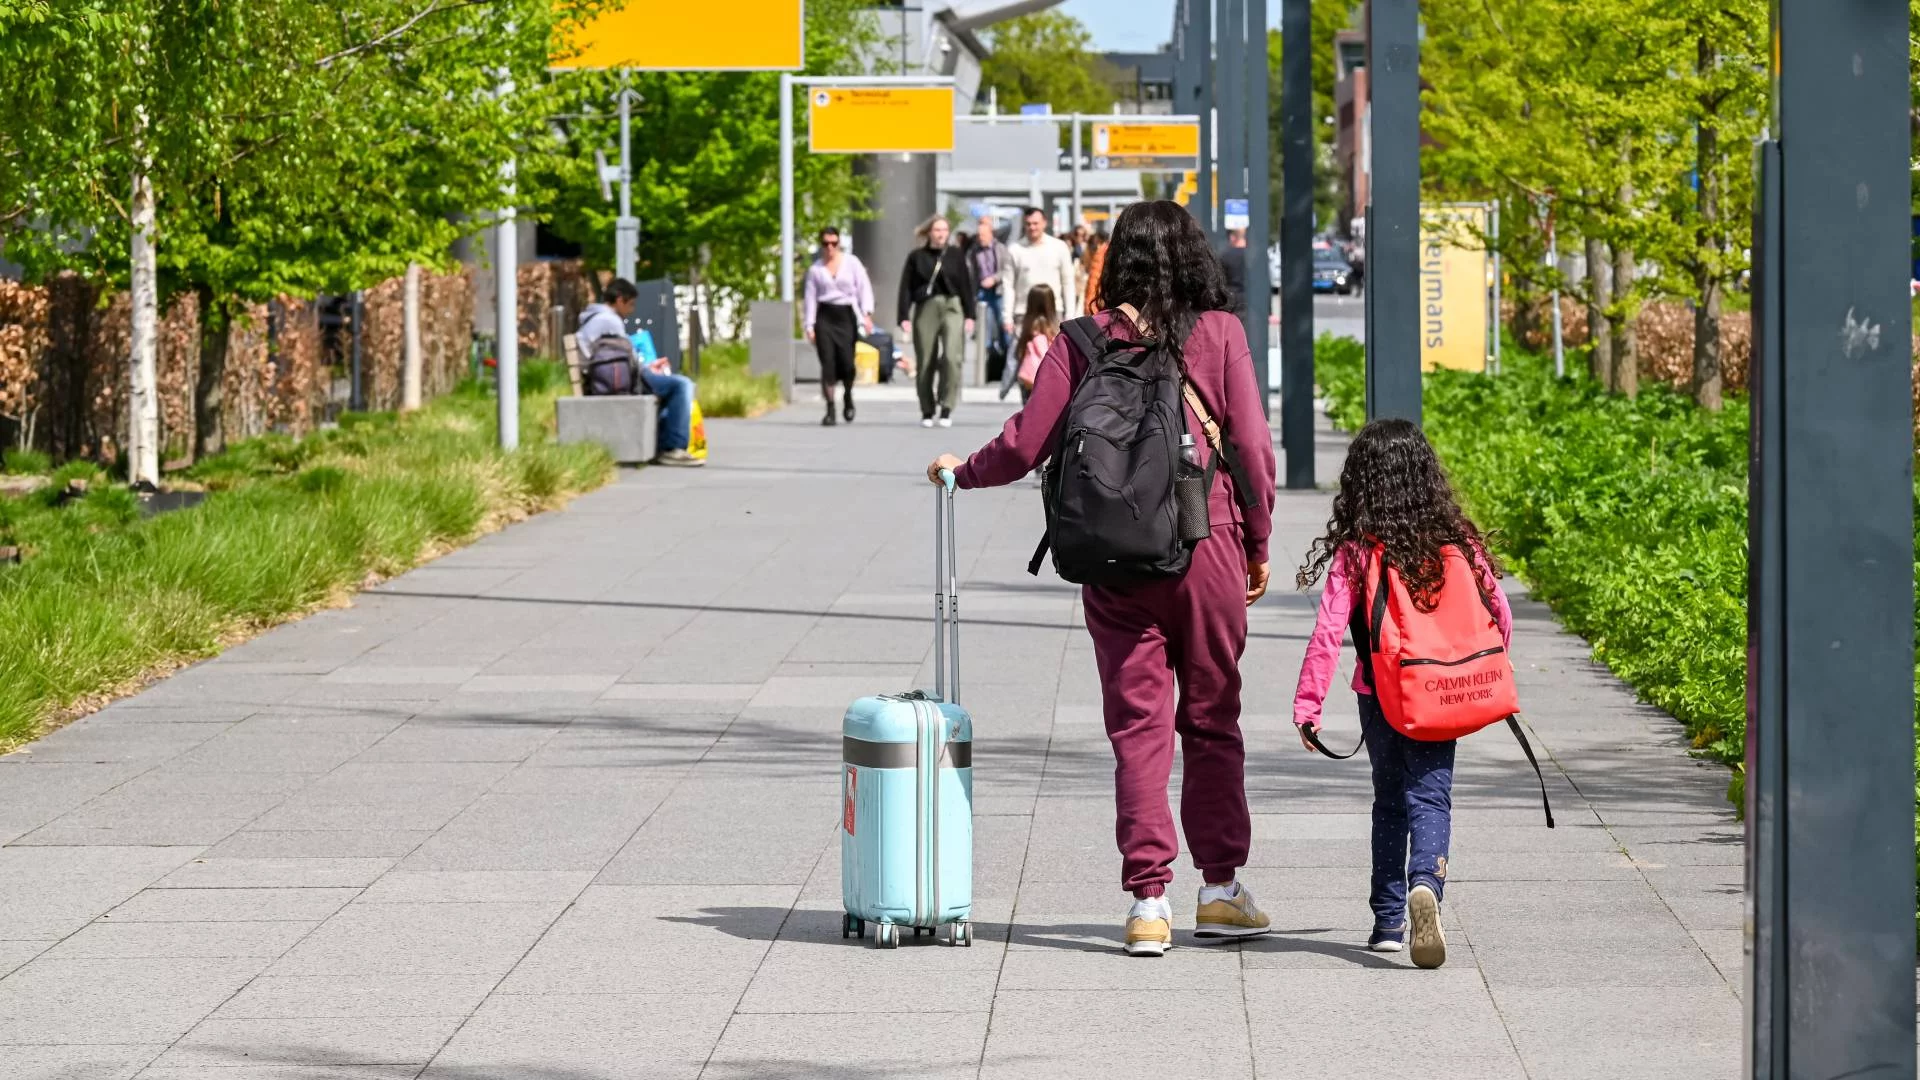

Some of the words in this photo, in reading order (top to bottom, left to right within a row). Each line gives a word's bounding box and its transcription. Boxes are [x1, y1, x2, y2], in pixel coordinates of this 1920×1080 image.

[1424, 674, 1471, 692] CALVIN
[1473, 669, 1503, 686] KLEIN
[1440, 692, 1465, 706] NEW
[1466, 687, 1493, 702] YORK
